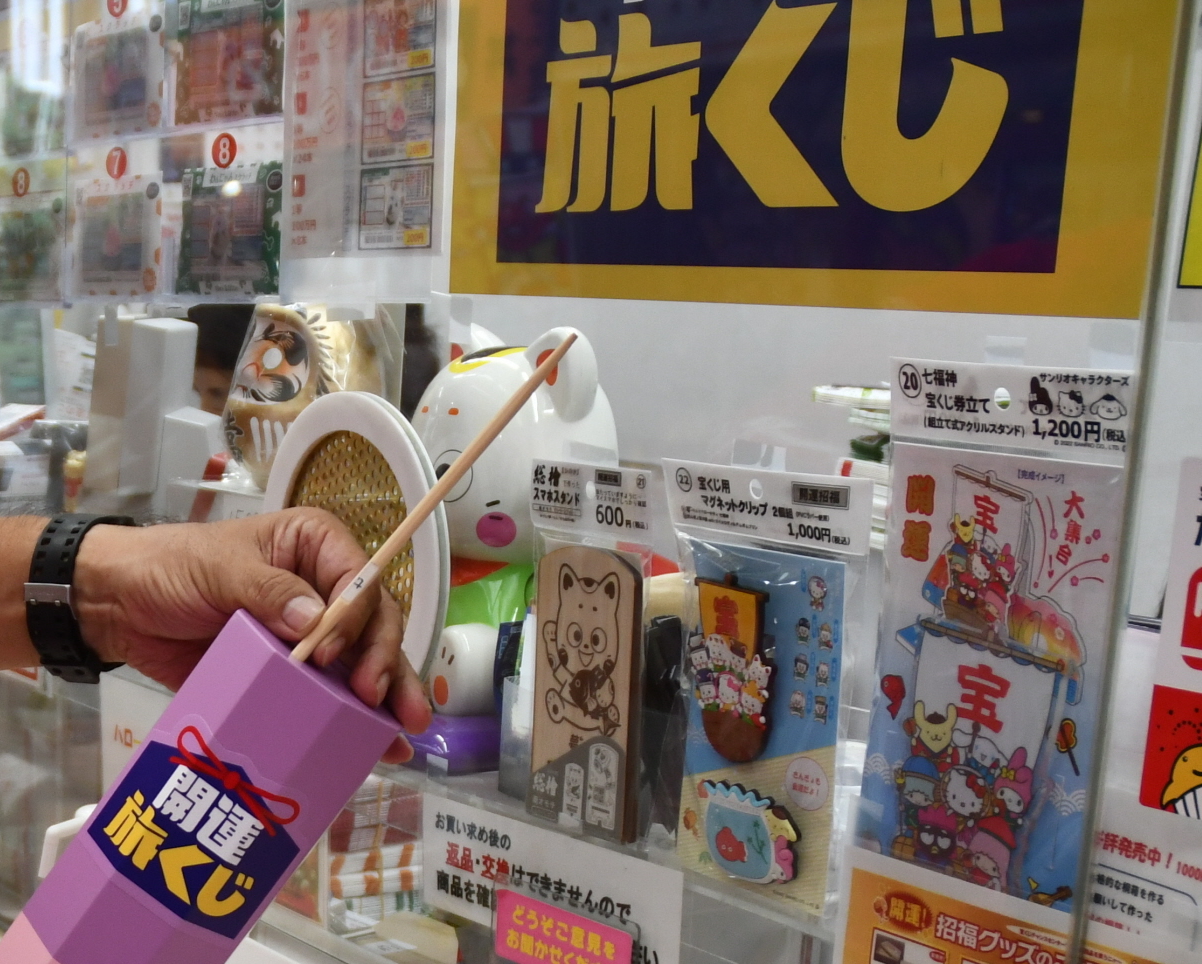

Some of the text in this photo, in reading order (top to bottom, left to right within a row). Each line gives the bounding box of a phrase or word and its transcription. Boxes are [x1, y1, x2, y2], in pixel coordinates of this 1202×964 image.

[535, 0, 1009, 213] 旅くじ
[922, 368, 958, 388] 七福神
[1039, 373, 1130, 386] サンリオキャラクターズ
[925, 391, 991, 414] 宝くじ券立て
[533, 487, 581, 506] スマホスタンド
[697, 476, 731, 494] 宝くじ用
[700, 494, 768, 516] マグネットクリップ
[799, 487, 841, 504] 開運招福
[973, 494, 1001, 534] 宝
[954, 663, 1011, 734] 宝
[151, 764, 265, 866] 開運
[435, 811, 512, 851] お買い求め後の
[103, 789, 255, 917] 旅くじ
[436, 869, 496, 911] 商品を確
[445, 841, 631, 926] 返品・交換はできませんので
